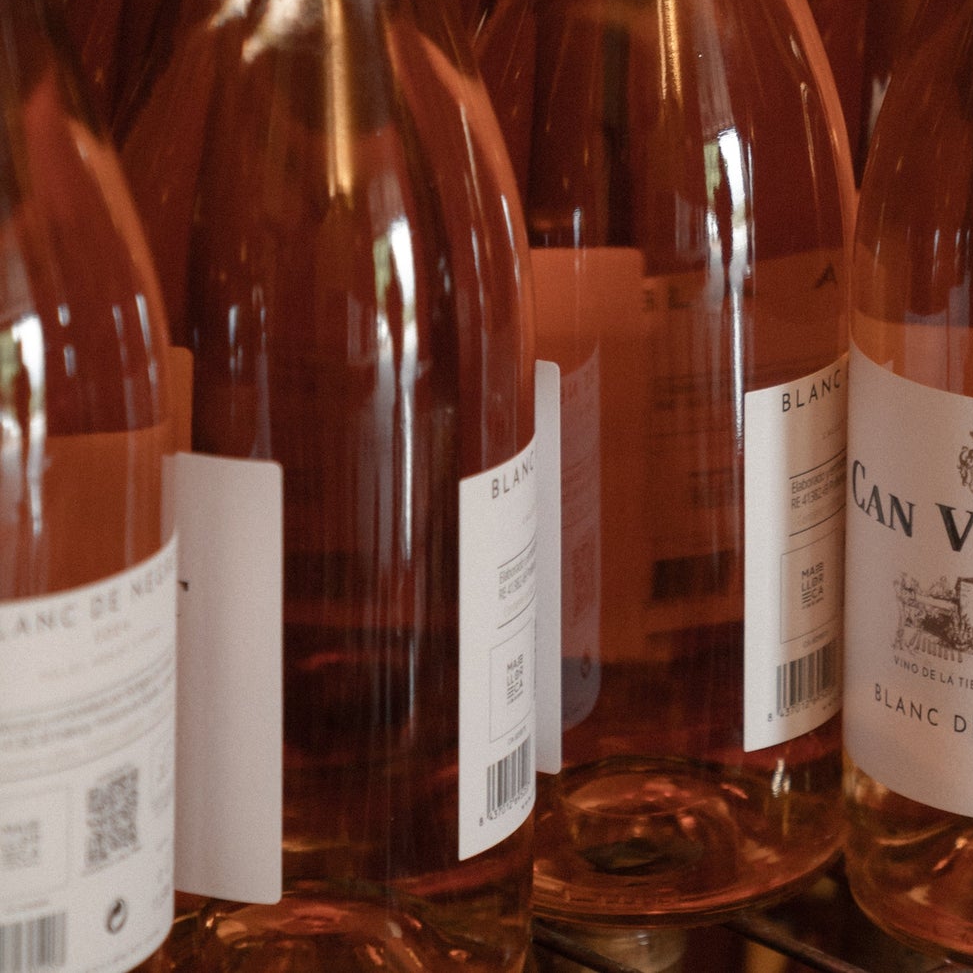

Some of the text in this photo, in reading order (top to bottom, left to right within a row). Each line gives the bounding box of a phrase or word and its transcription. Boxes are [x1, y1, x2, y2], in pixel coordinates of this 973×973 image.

[782, 369, 842, 413] BLANC
[852, 459, 916, 538] CAN
[894, 655, 919, 674] VINO
[922, 667, 936, 680] DE
[940, 672, 954, 686] LA
[875, 683, 939, 726] BLANC
